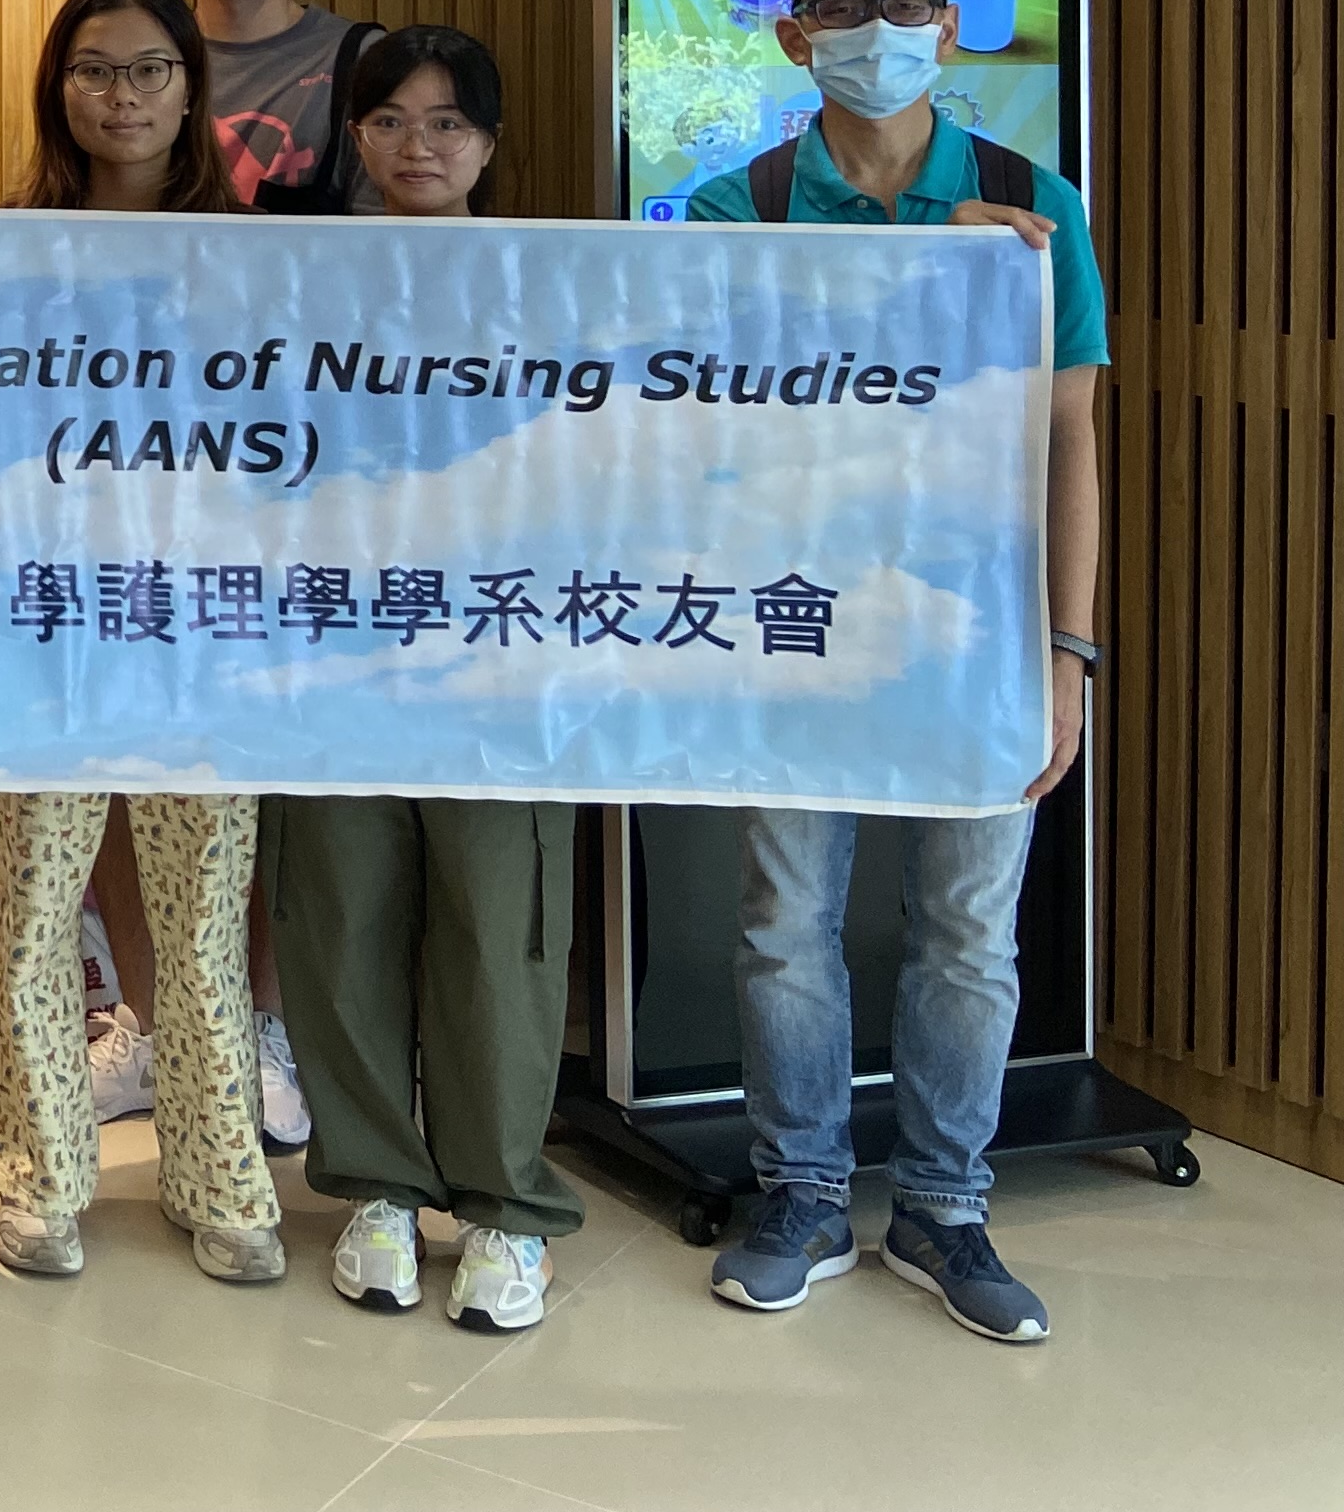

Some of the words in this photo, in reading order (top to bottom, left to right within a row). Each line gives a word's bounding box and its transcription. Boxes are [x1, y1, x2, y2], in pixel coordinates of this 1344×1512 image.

[202, 337, 288, 391] of
[303, 340, 615, 412] Nursing
[639, 349, 942, 406] Studies
[45, 416, 320, 489] (AANS)
